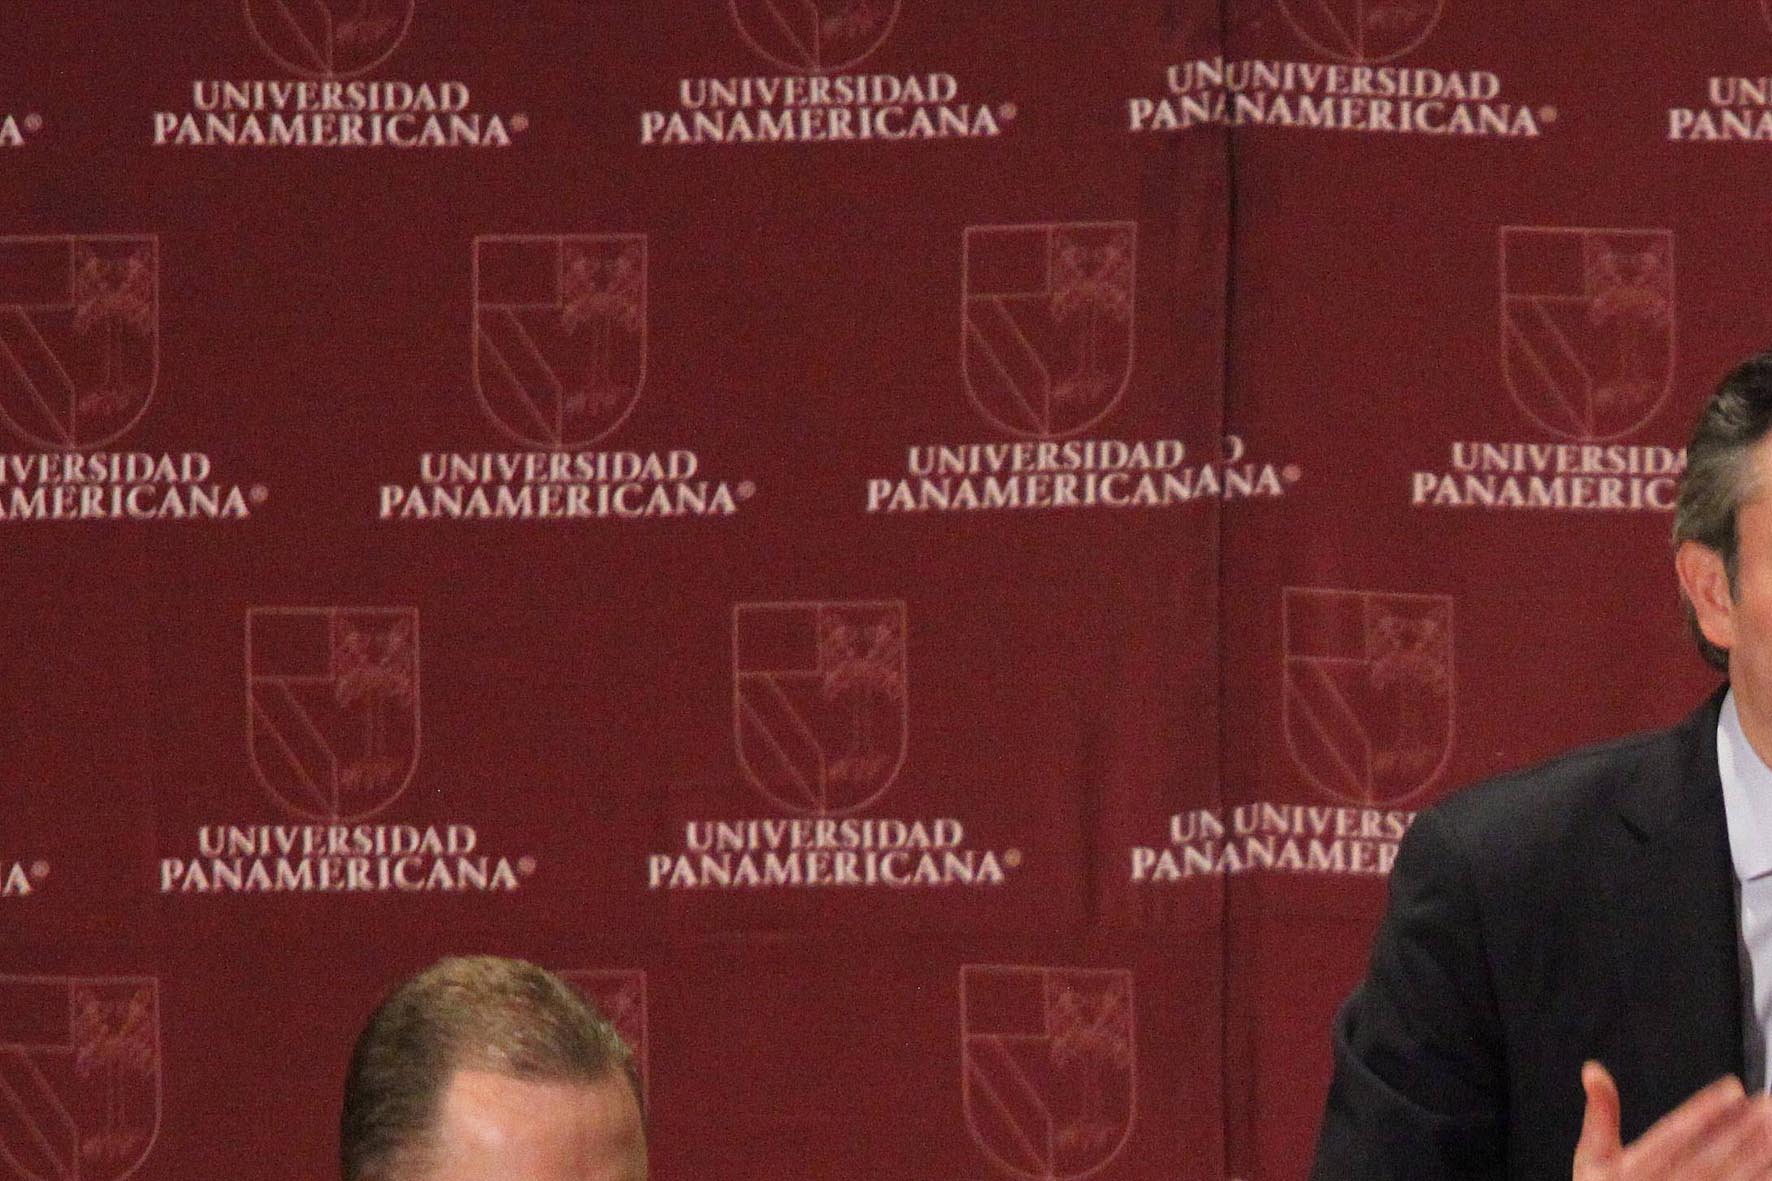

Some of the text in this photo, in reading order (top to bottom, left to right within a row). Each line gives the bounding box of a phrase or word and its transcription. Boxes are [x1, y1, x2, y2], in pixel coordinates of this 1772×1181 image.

[194, 81, 469, 111] UNIVERSIDAD
[681, 74, 957, 107] UNIVERSIDAD
[155, 113, 509, 145] PANAMERICANA
[0, 451, 212, 484] IVERSIDAD
[421, 451, 697, 484] UNIVERSIDAD
[380, 484, 735, 518] PANAMERICANA
[1411, 471, 1678, 510] PANAMERIC
[199, 825, 476, 858] UNIVERSIDAD
[687, 819, 963, 850] UNIVERSIDAD
[162, 855, 517, 891] PANAMERICANA
[650, 848, 1003, 887] PANAMERICANA
